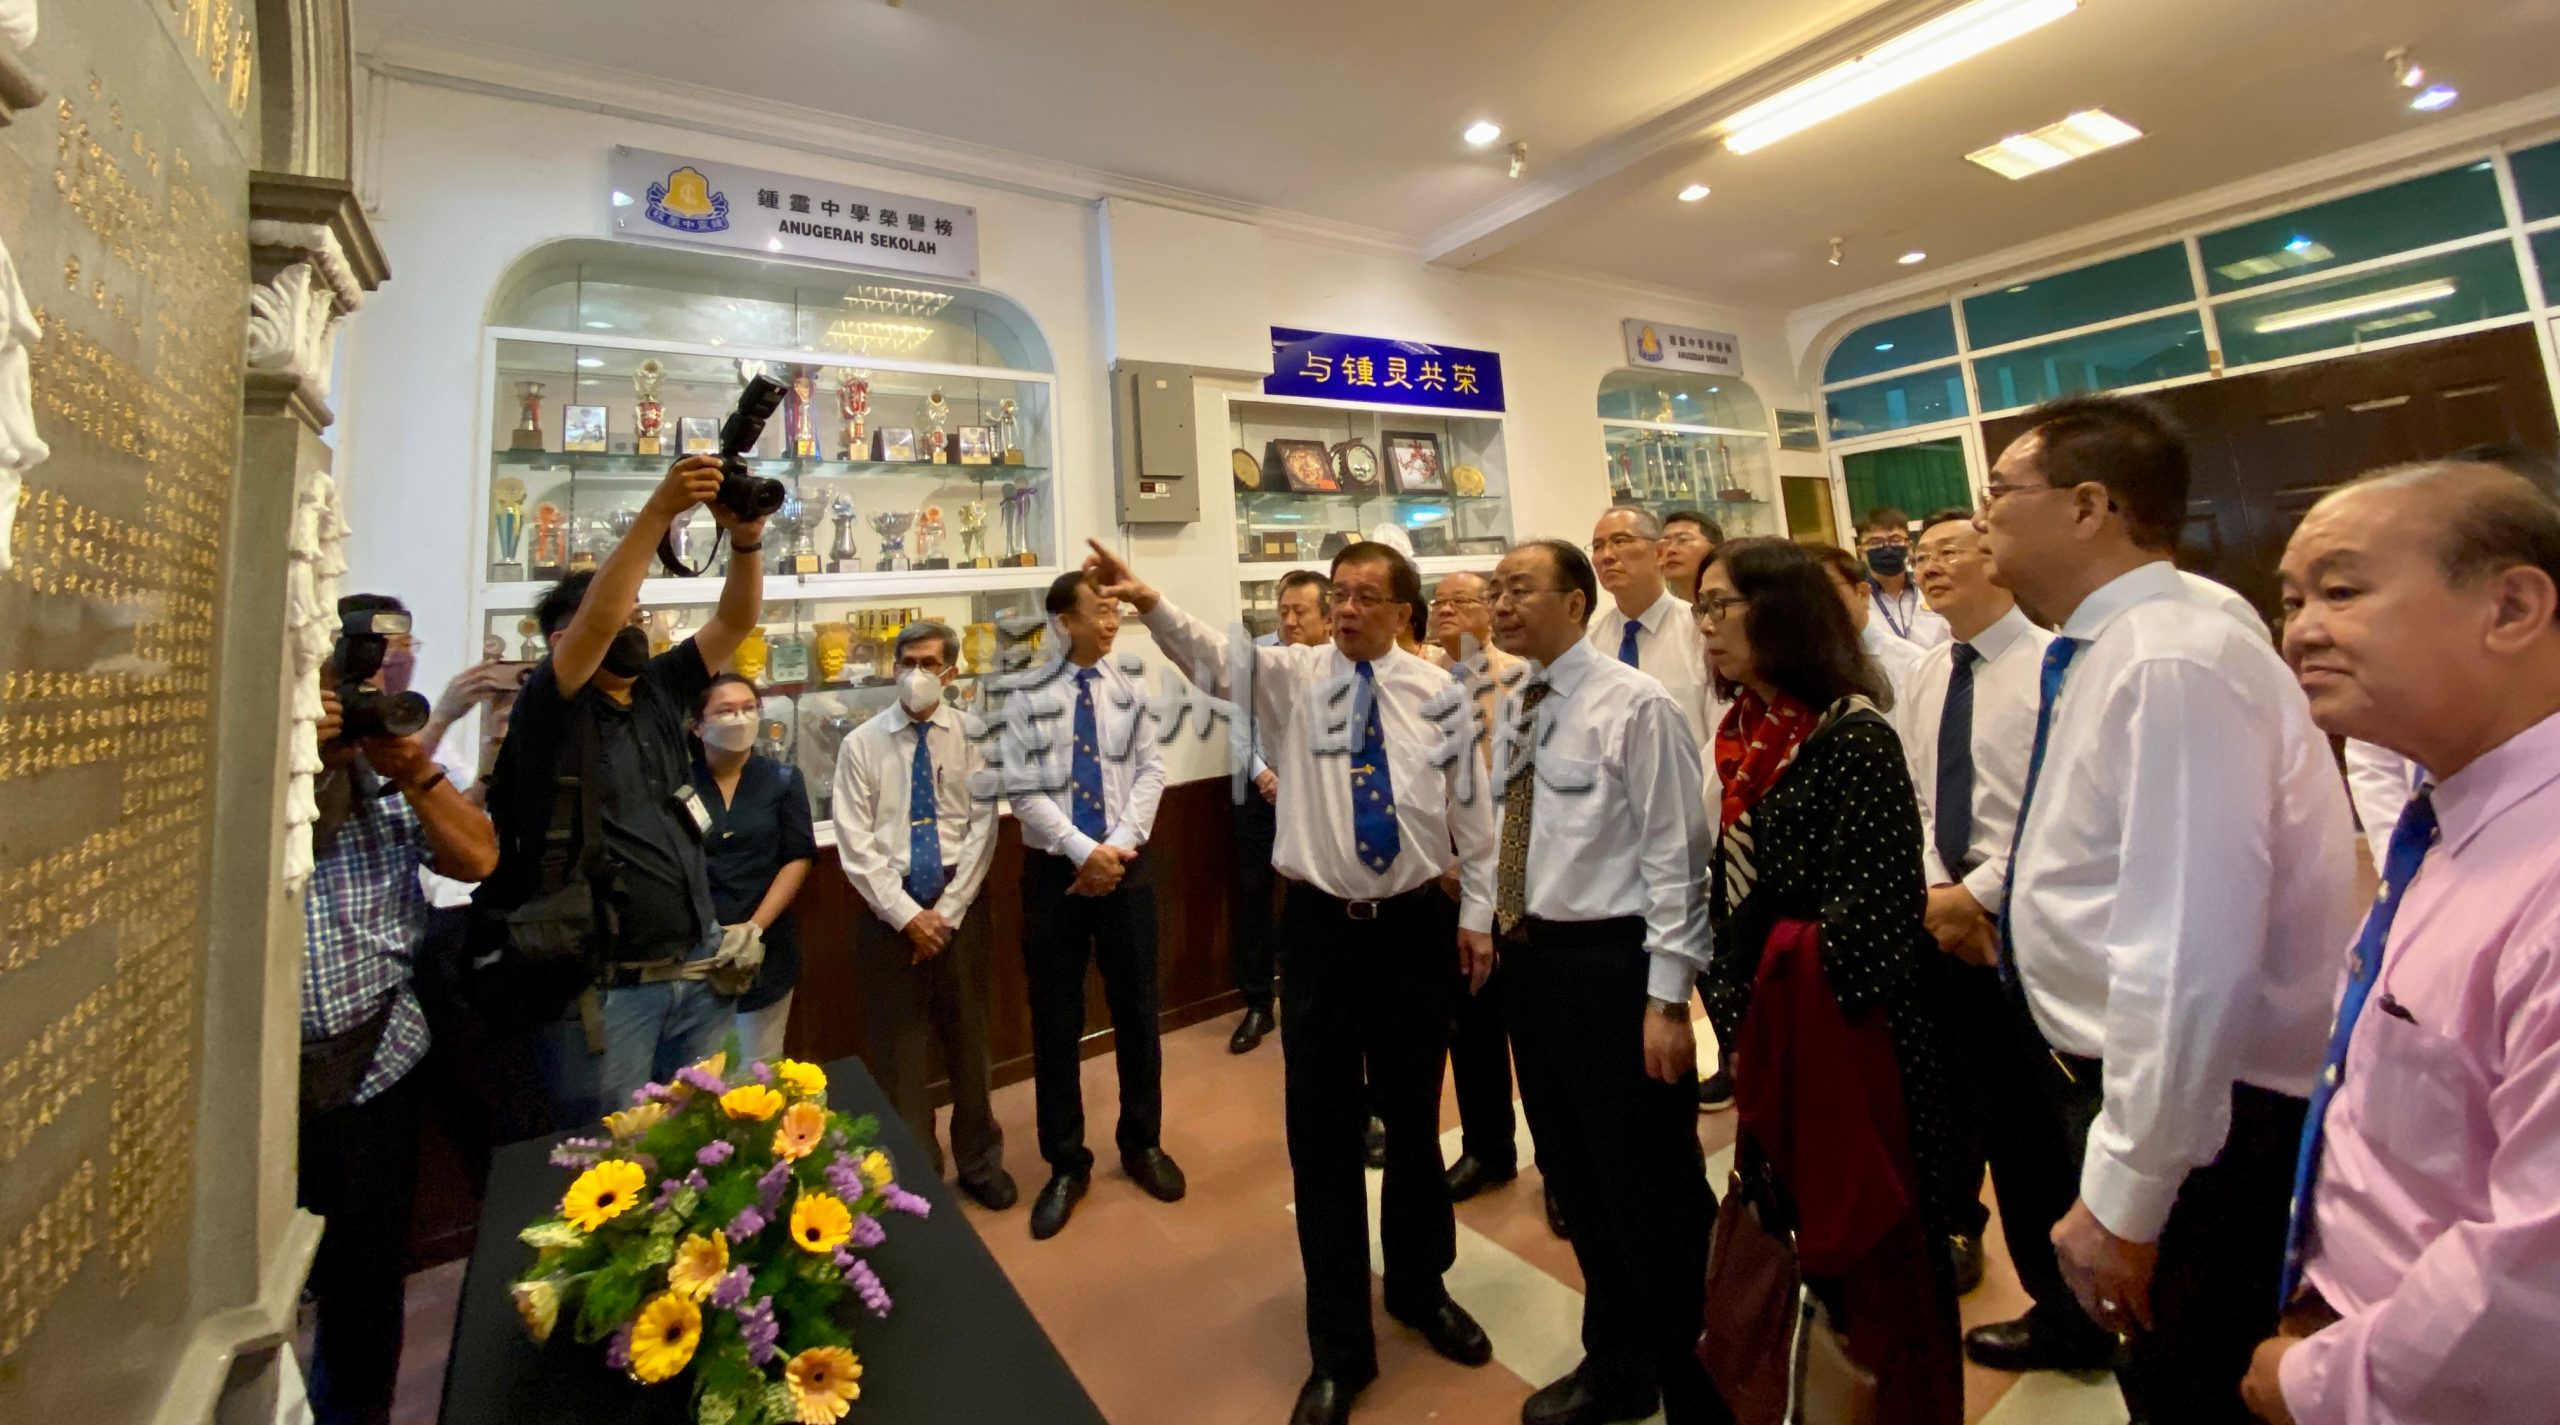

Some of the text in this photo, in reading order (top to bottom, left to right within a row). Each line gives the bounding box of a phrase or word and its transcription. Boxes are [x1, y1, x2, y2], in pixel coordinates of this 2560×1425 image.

[779, 219, 937, 255] ANUGERAH SEKOLAH
[1299, 351, 1480, 395] 与锺灵共荣
